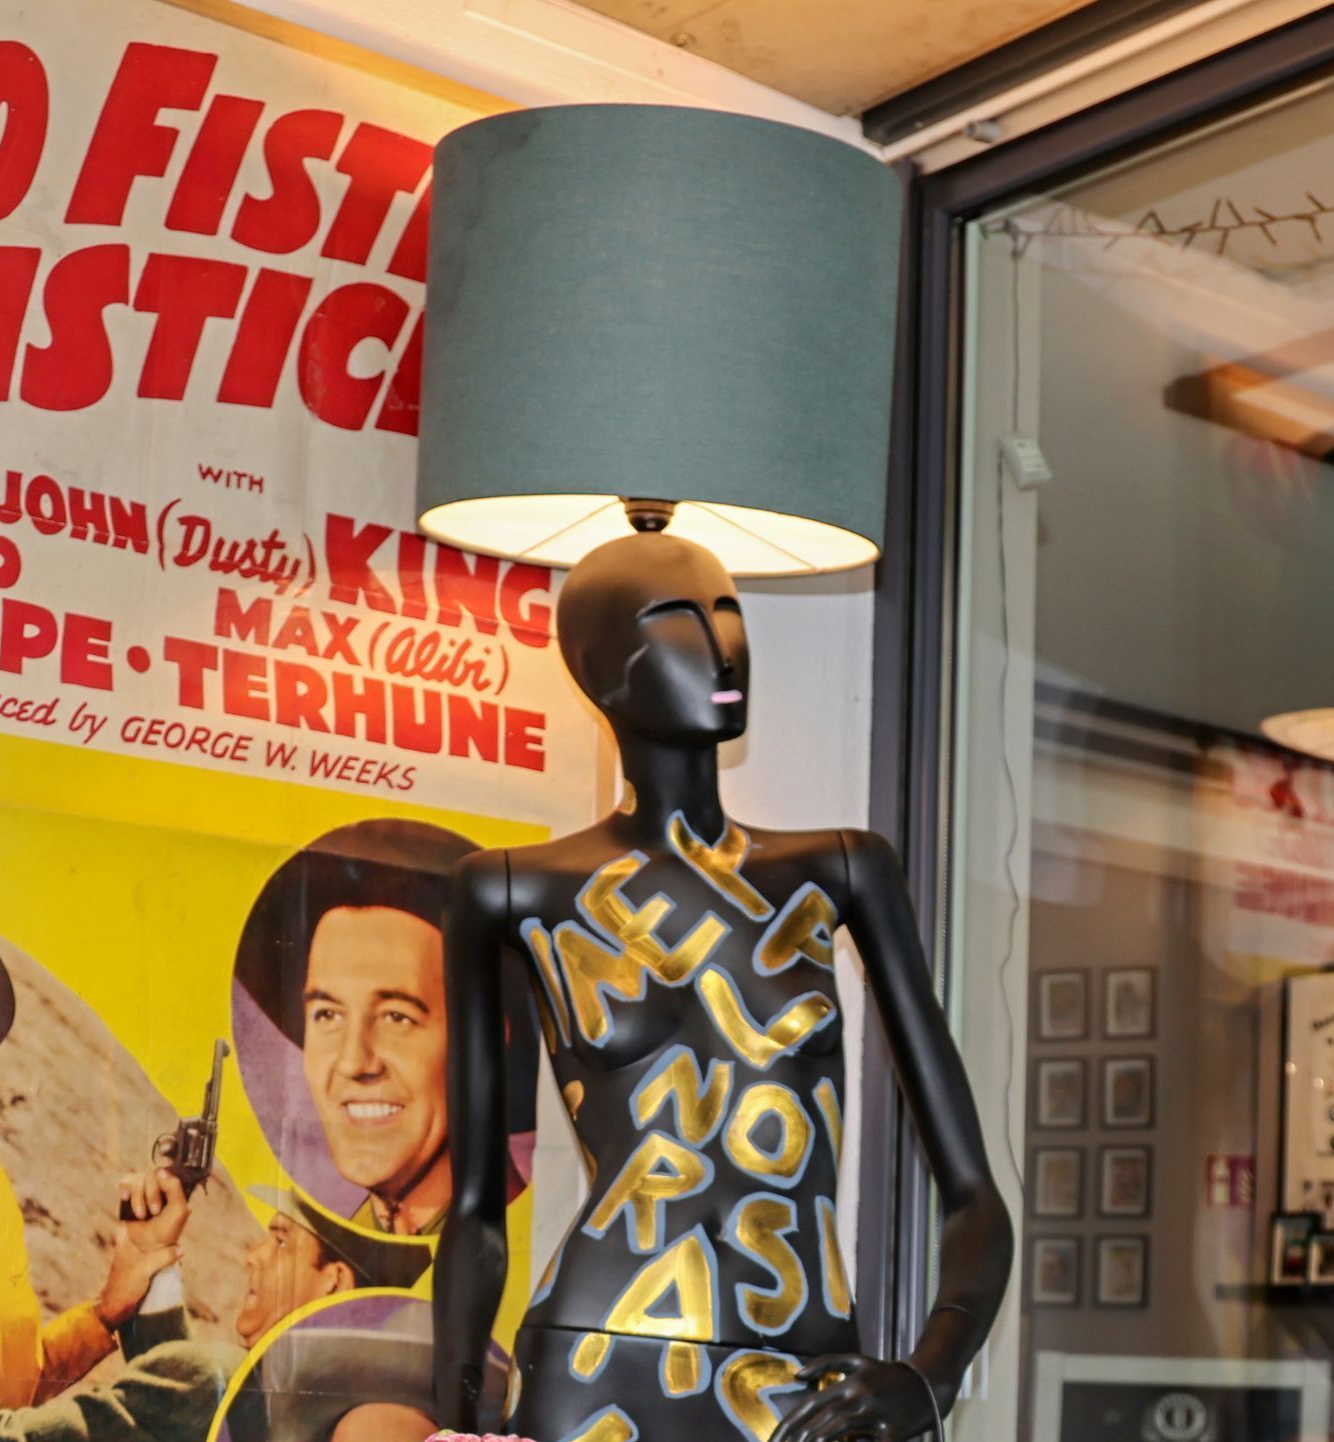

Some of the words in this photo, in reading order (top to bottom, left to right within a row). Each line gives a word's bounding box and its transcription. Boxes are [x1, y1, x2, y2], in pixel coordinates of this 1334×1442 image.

[64, 41, 433, 284] FIST
[198, 463, 264, 493] WITH
[157, 498, 316, 596] (Dusty)
[325, 512, 556, 647] KING
[215, 588, 363, 666] MAX
[69, 702, 108, 744] by
[120, 716, 255, 761] GEORGE
[267, 740, 296, 771] W.
[310, 749, 417, 791] WEEKS
[165, 635, 545, 772] TERHUNE
